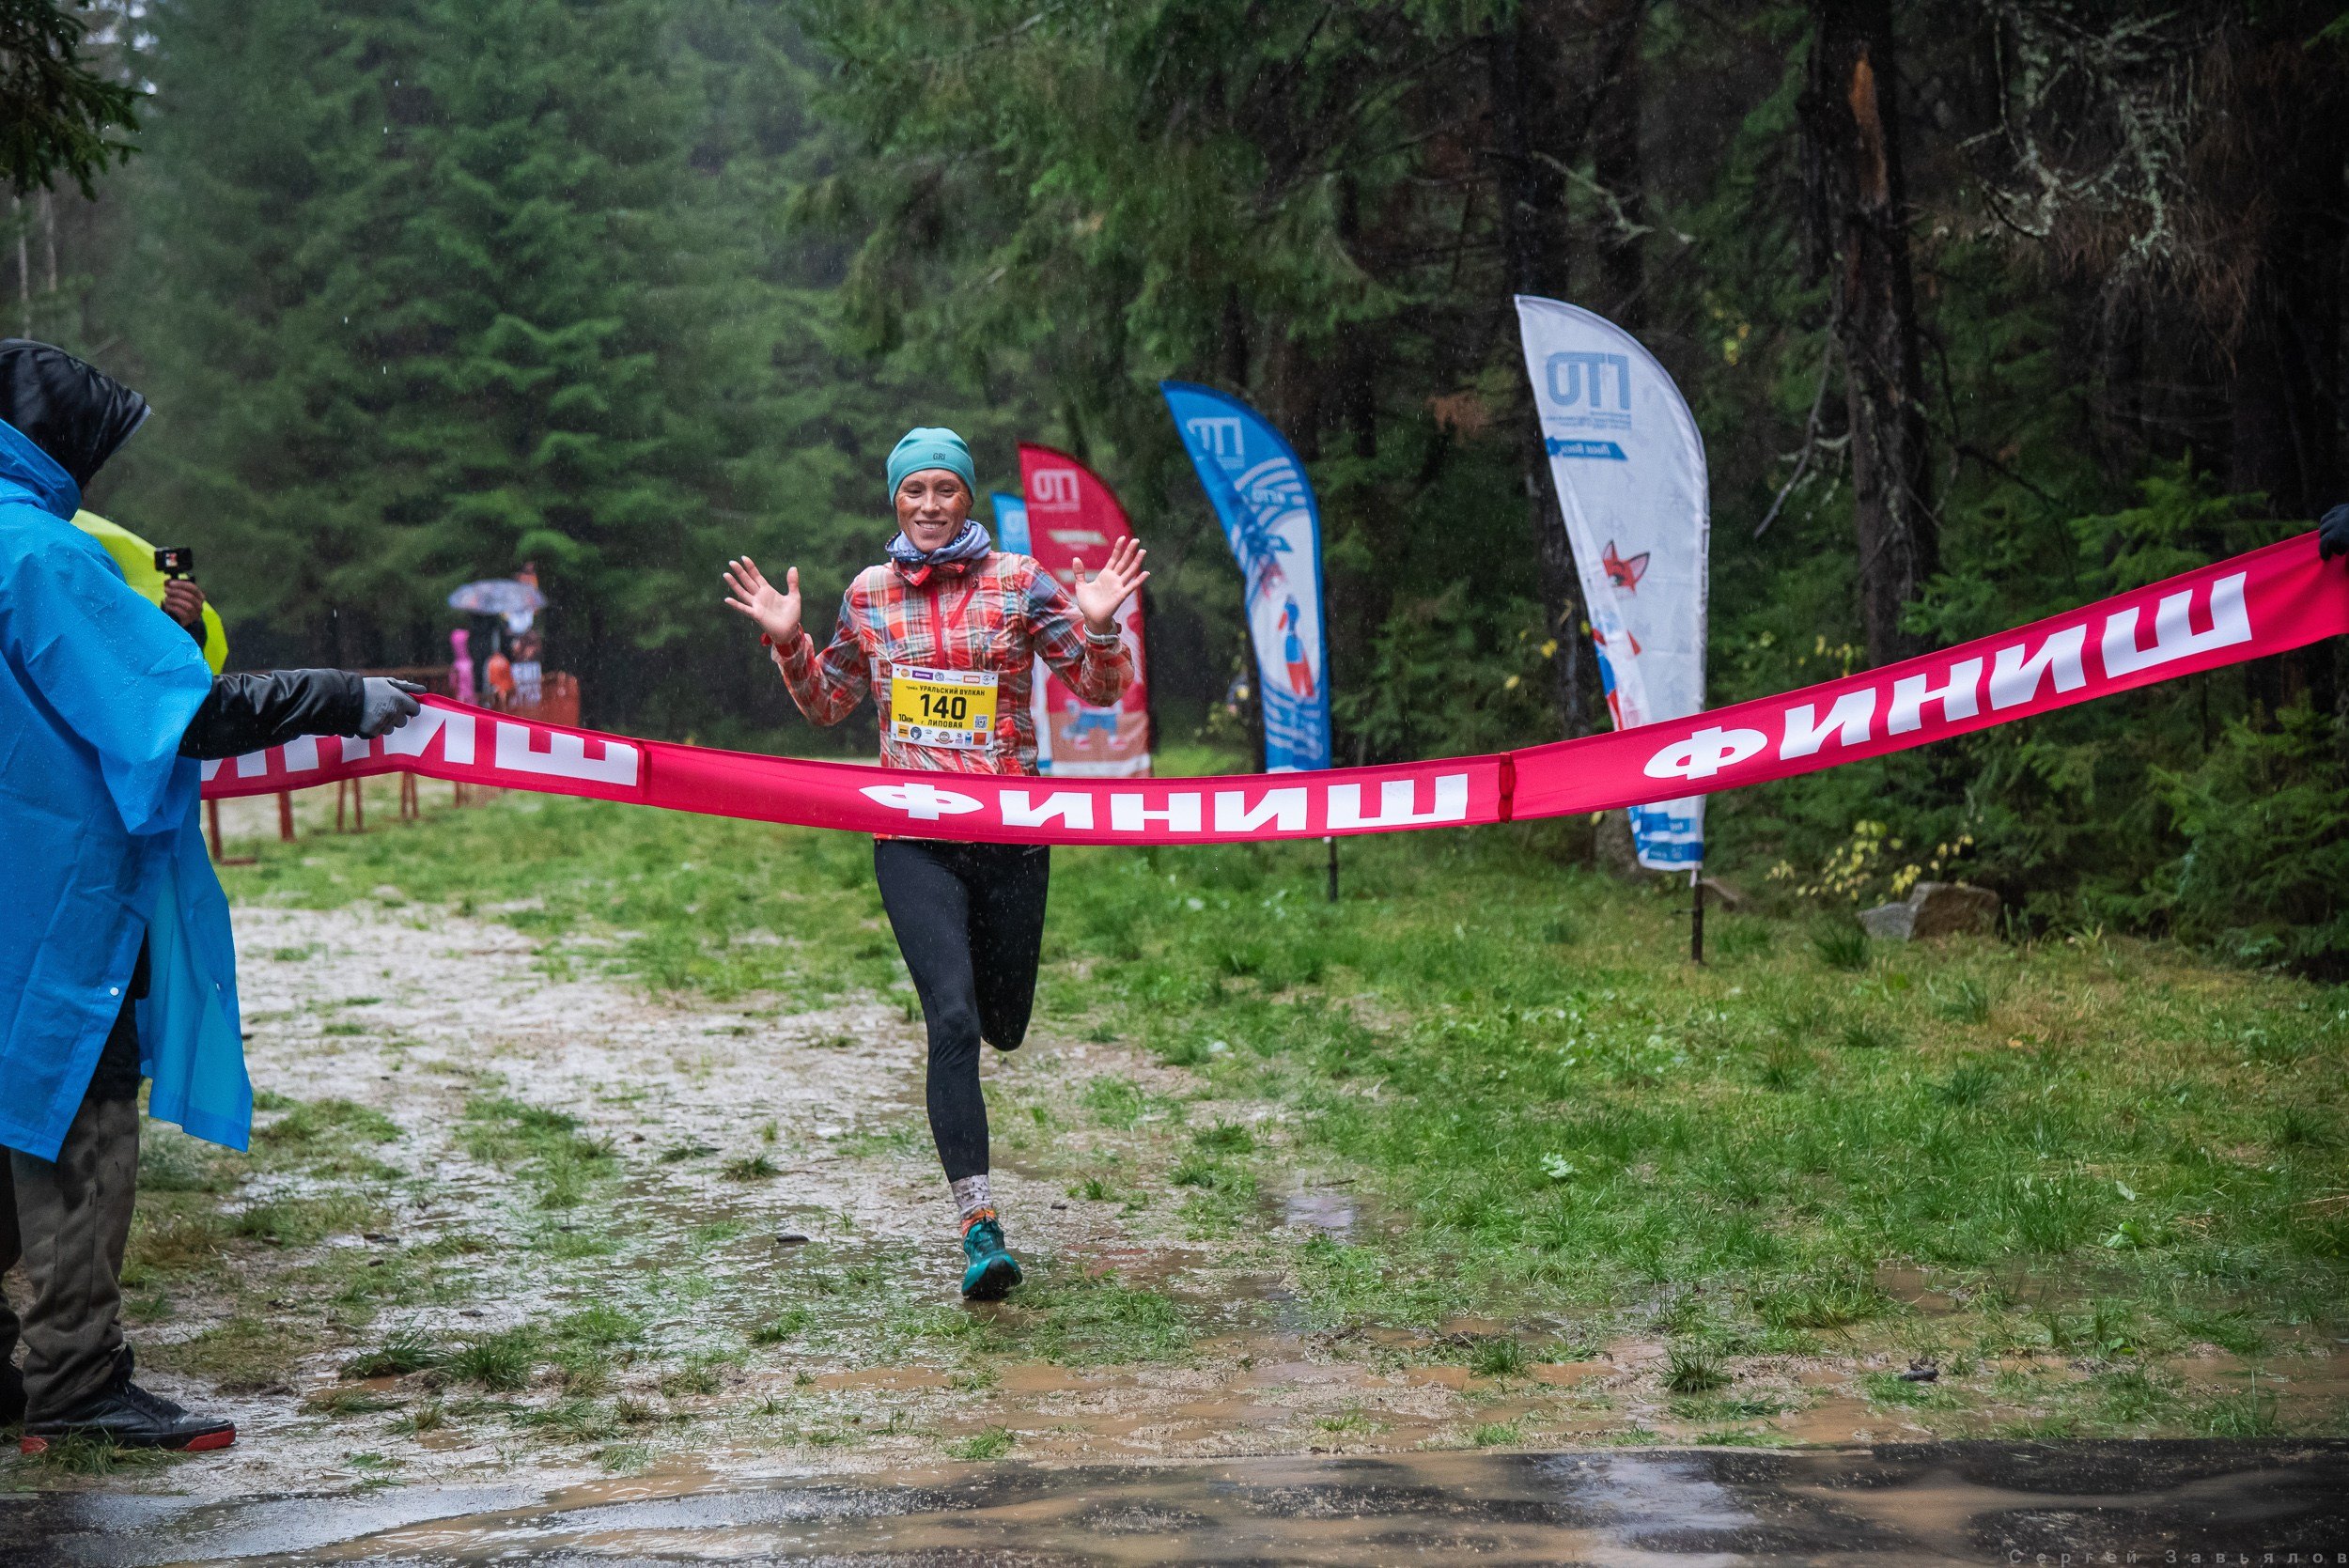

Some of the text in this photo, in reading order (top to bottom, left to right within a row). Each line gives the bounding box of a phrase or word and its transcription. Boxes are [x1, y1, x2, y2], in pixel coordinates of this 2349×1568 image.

[1643, 571, 2252, 781] ФИНИШ
[920, 685, 958, 695] УРАЛЬСКИЙ
[920, 693, 967, 720] 140
[927, 719, 963, 728] ЛИПОВАЯ
[859, 773, 1469, 832] ФИНИШ
